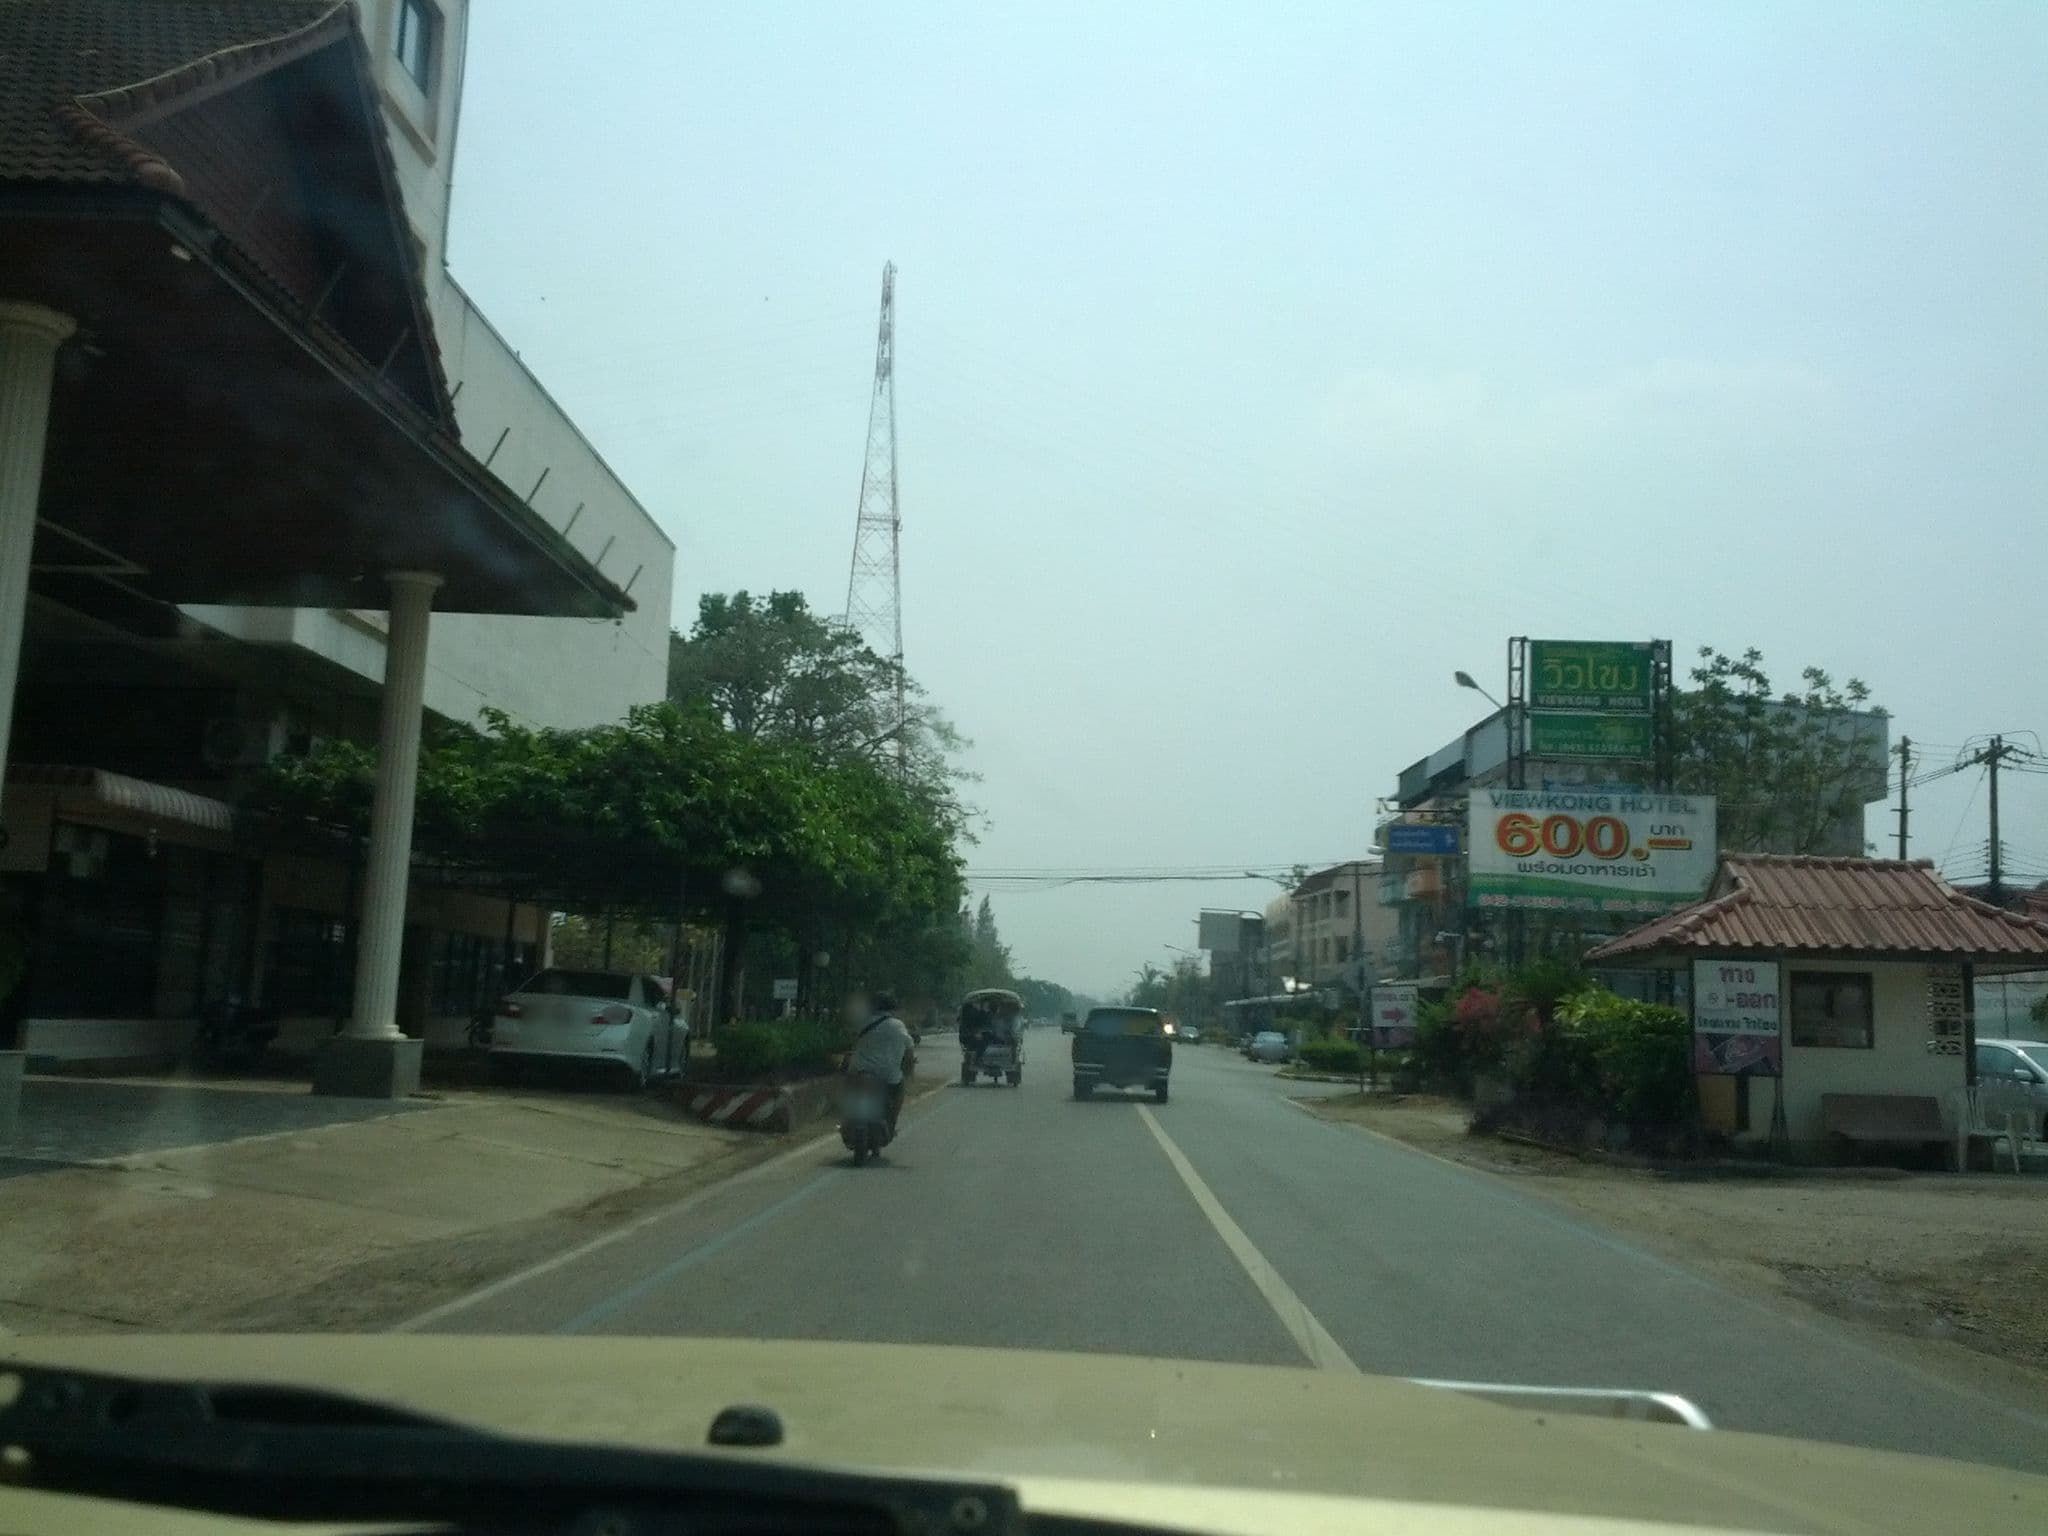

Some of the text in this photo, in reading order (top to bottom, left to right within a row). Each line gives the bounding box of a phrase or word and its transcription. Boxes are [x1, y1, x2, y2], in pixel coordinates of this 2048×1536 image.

[1542, 656, 1639, 690] วิวโขง
[1608, 696, 1643, 707] HOTEL
[1490, 793, 1697, 814] VIEWKONG HOTEL
[1517, 861, 1657, 878] พร้อมอาหารเช้า
[1719, 967, 1755, 984] ทาง
